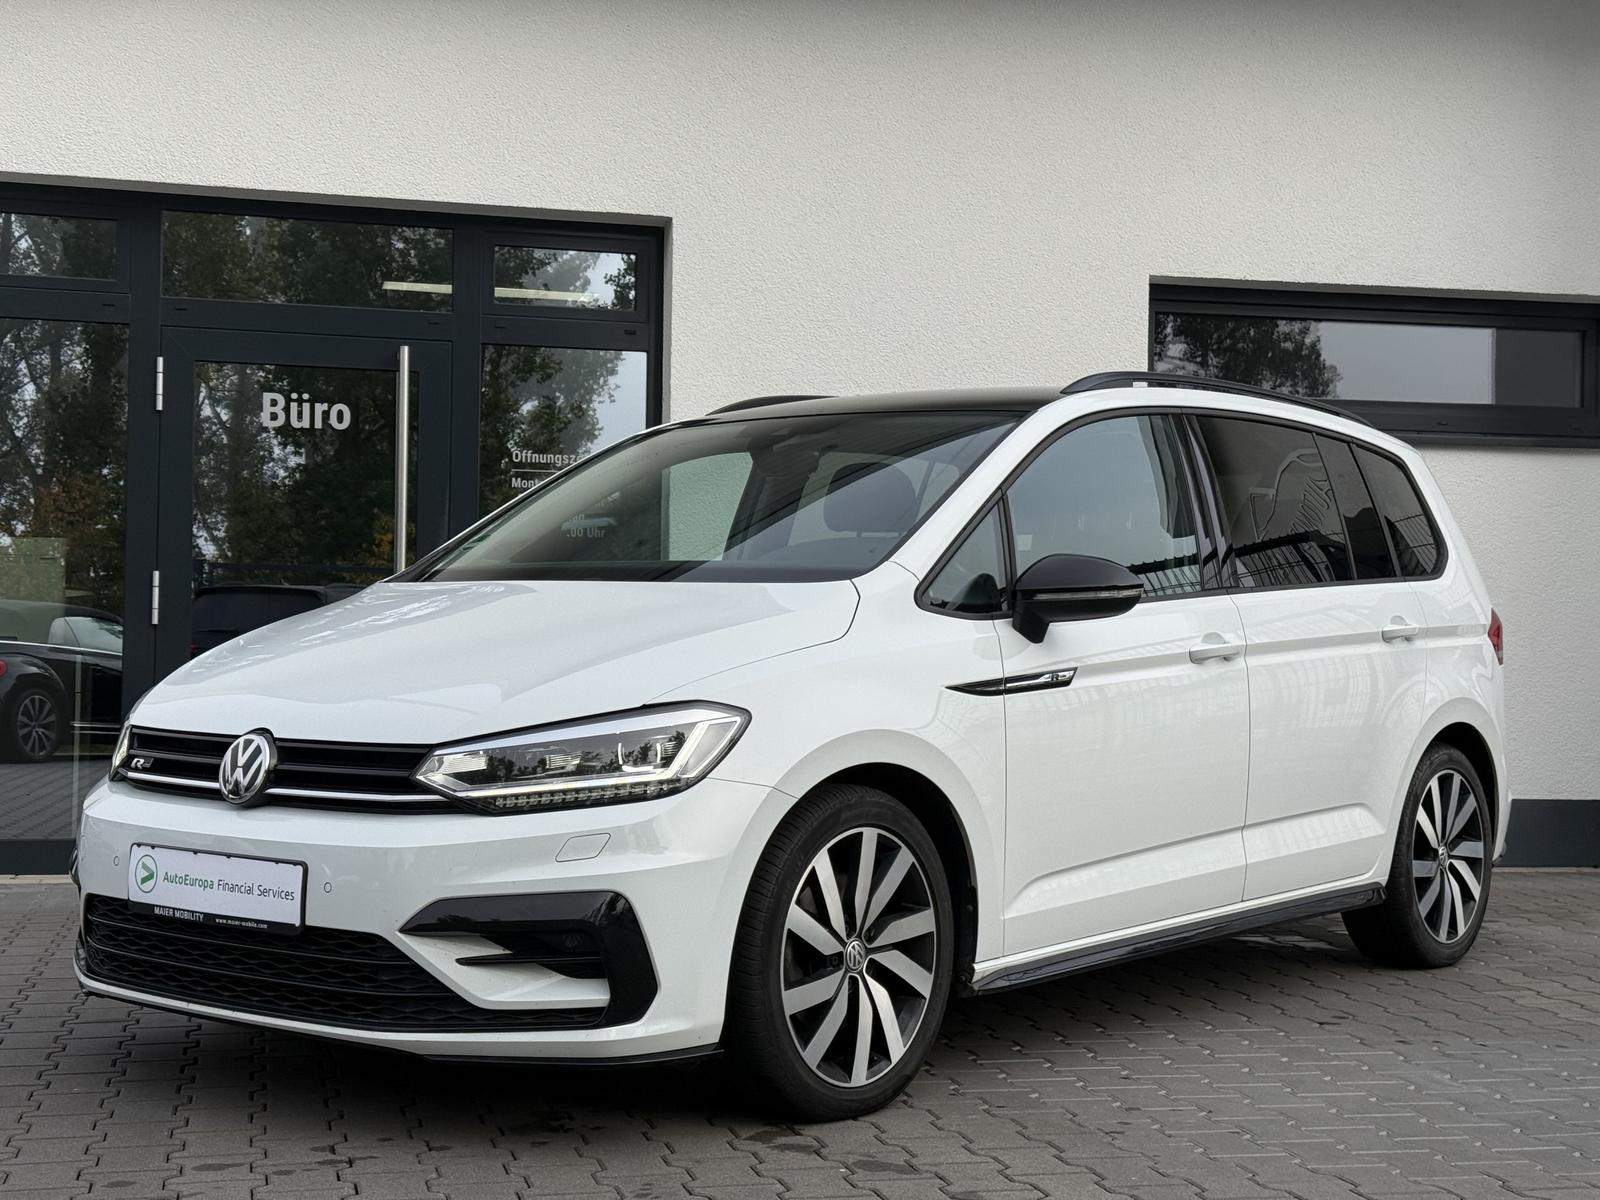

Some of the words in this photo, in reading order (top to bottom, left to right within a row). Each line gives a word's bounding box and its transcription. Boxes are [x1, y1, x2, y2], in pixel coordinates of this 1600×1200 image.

[262, 391, 351, 430] Büro
[511, 477, 544, 488] Mont
[587, 527, 606, 538] Uhr
[163, 871, 214, 891] AutoEuropa
[217, 879, 254, 896] Financial
[257, 884, 295, 901] Services
[154, 906, 174, 917] MAIER
[174, 909, 204, 922] MOBILITY
